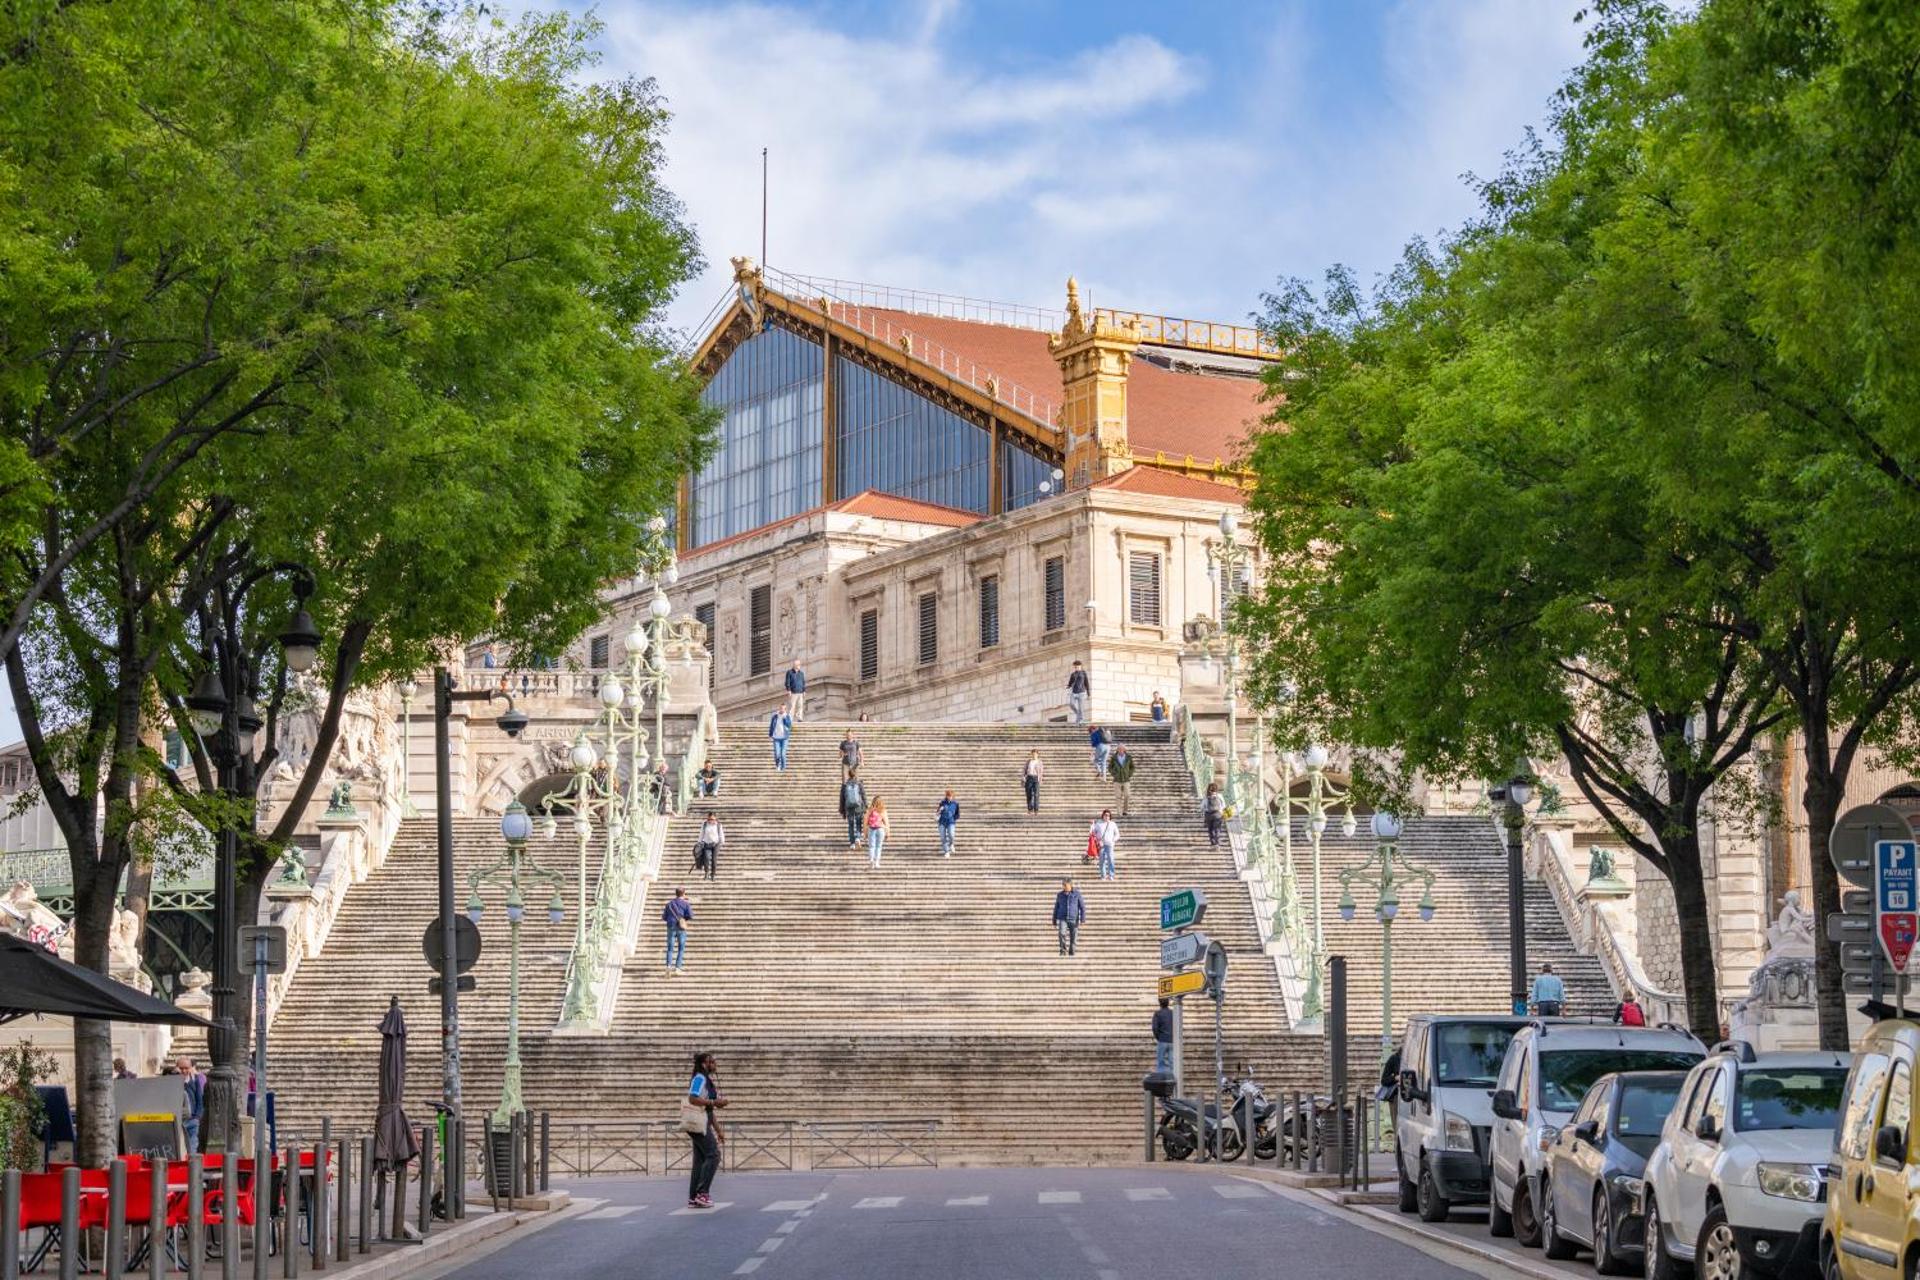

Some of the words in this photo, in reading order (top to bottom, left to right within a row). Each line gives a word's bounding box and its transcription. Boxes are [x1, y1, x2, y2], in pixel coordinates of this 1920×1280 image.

[535, 727, 576, 738] ARRIV
[1890, 845, 1905, 868] P
[1883, 867, 1913, 877] PAYANT
[1171, 895, 1189, 909] TOULON
[1171, 907, 1193, 922] AUBAGNE
